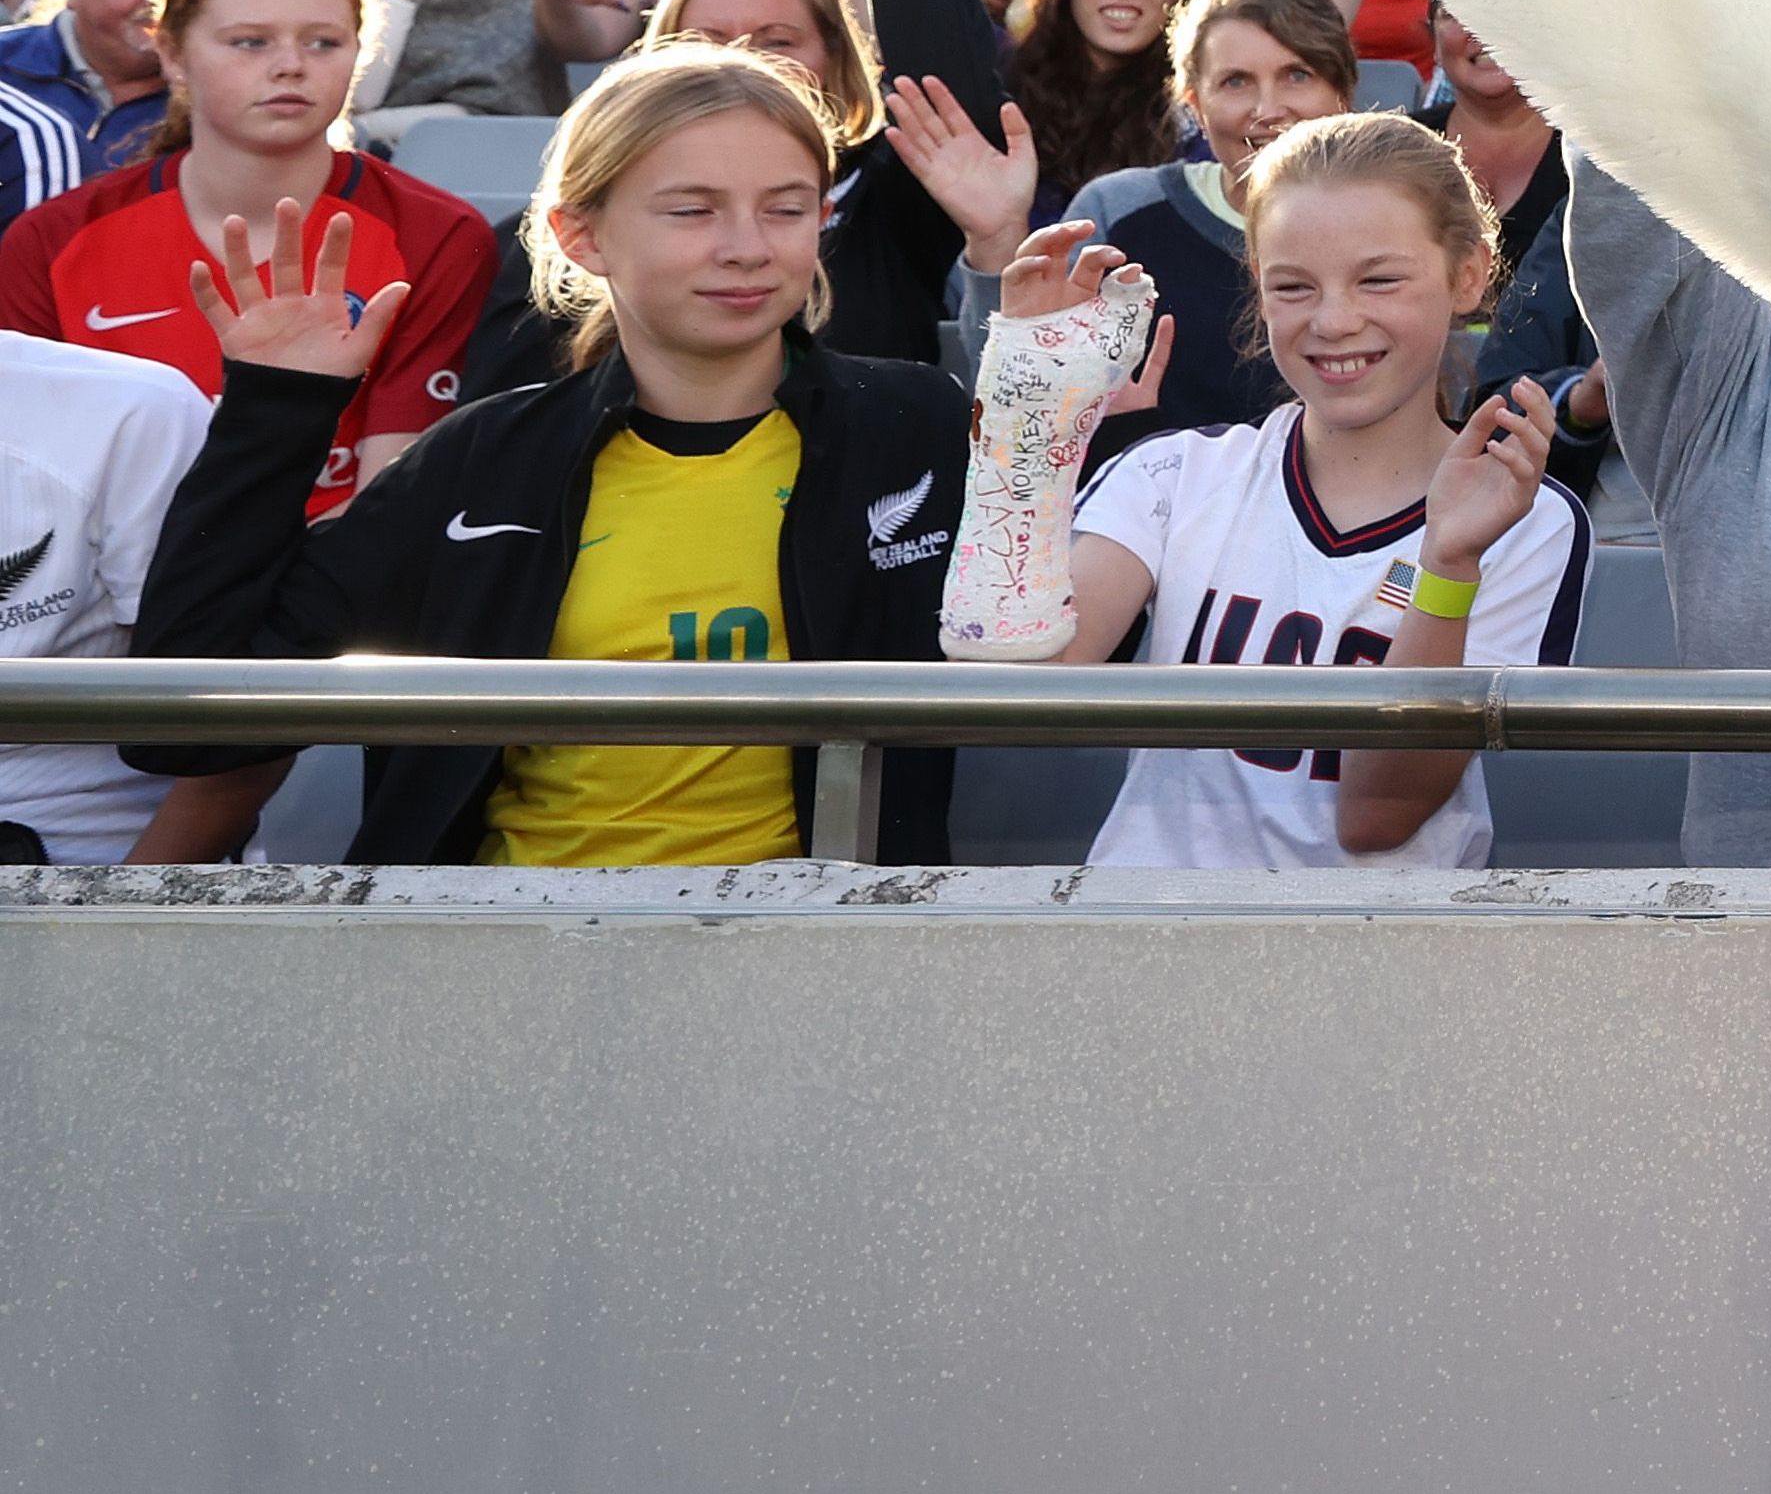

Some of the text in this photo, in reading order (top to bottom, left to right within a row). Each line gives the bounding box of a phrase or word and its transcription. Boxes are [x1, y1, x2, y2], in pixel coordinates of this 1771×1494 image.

[875, 544, 942, 571] FOOTBALL
[889, 530, 950, 557] ZEALAND
[7, 588, 76, 618] ZEALAND
[0, 603, 68, 632] OOTBALL
